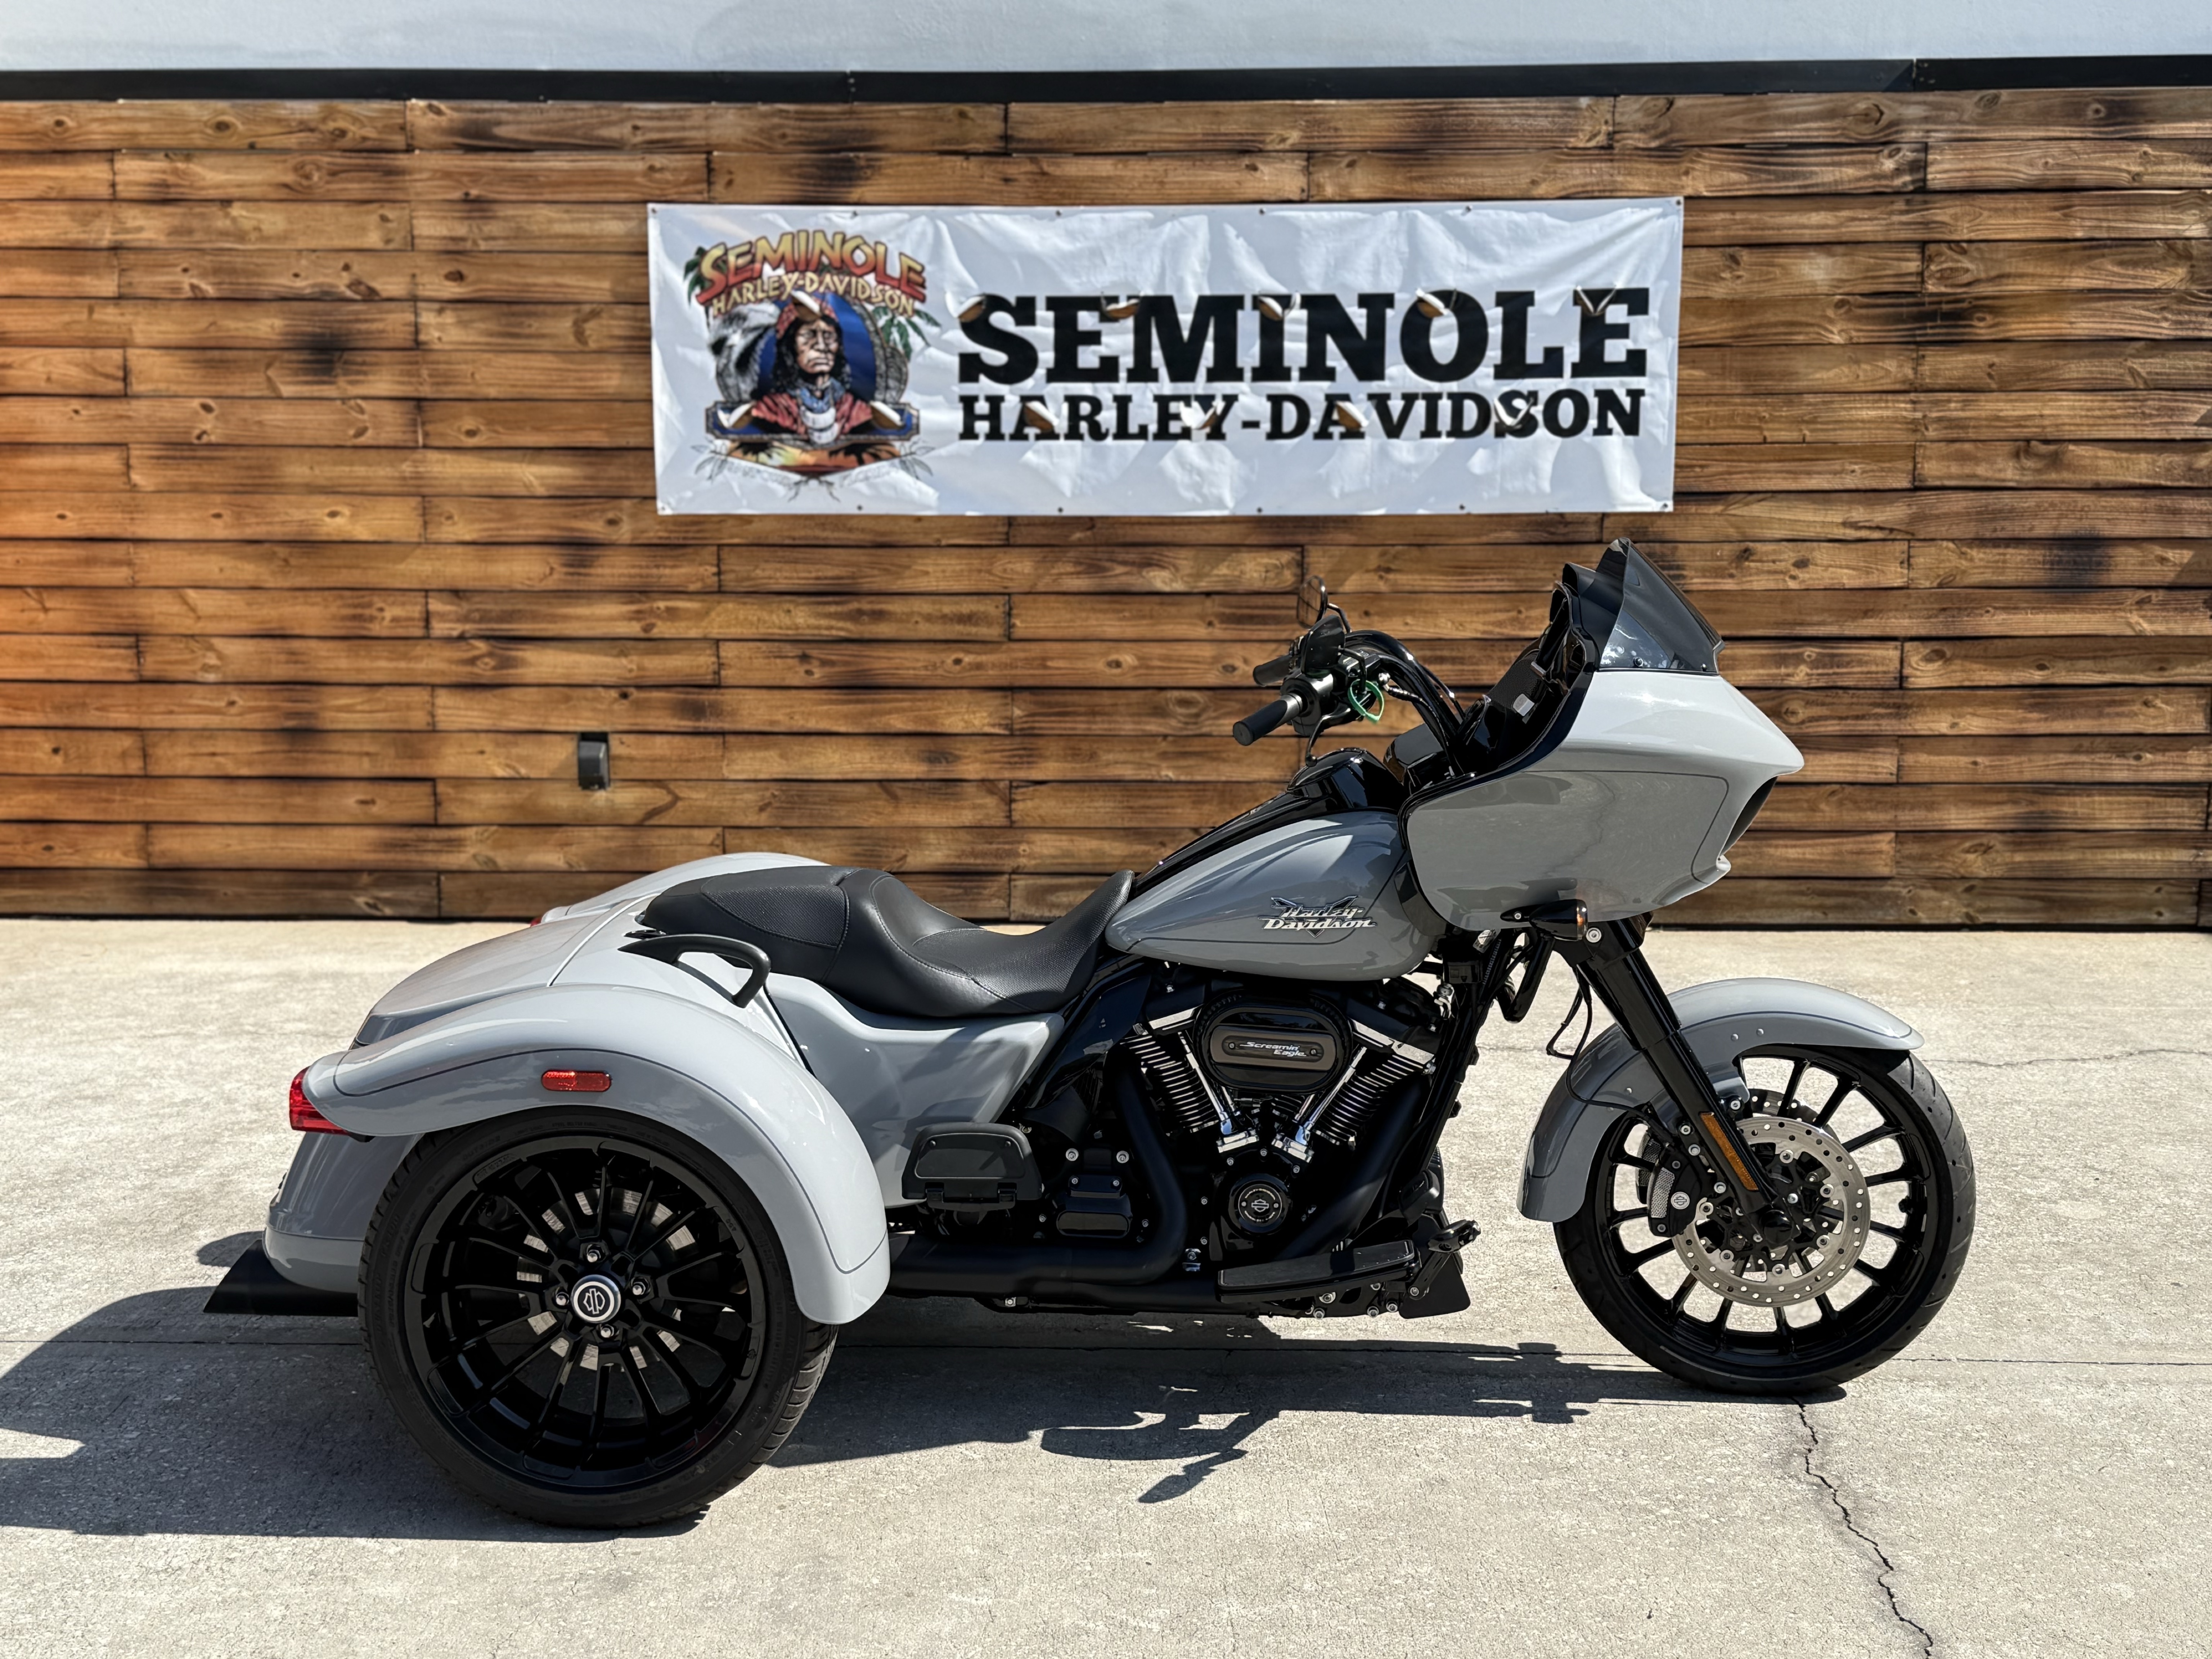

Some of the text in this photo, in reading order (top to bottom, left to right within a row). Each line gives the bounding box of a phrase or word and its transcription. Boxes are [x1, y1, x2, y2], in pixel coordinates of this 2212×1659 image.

[696, 230, 926, 305] SEMINOLE
[712, 272, 915, 318] HARLEY-DAVIDSON
[958, 287, 1649, 385] SEMINOLE
[959, 388, 1645, 441] HARLEY-DAVIDSON
[1259, 917, 1377, 931] Davidson
